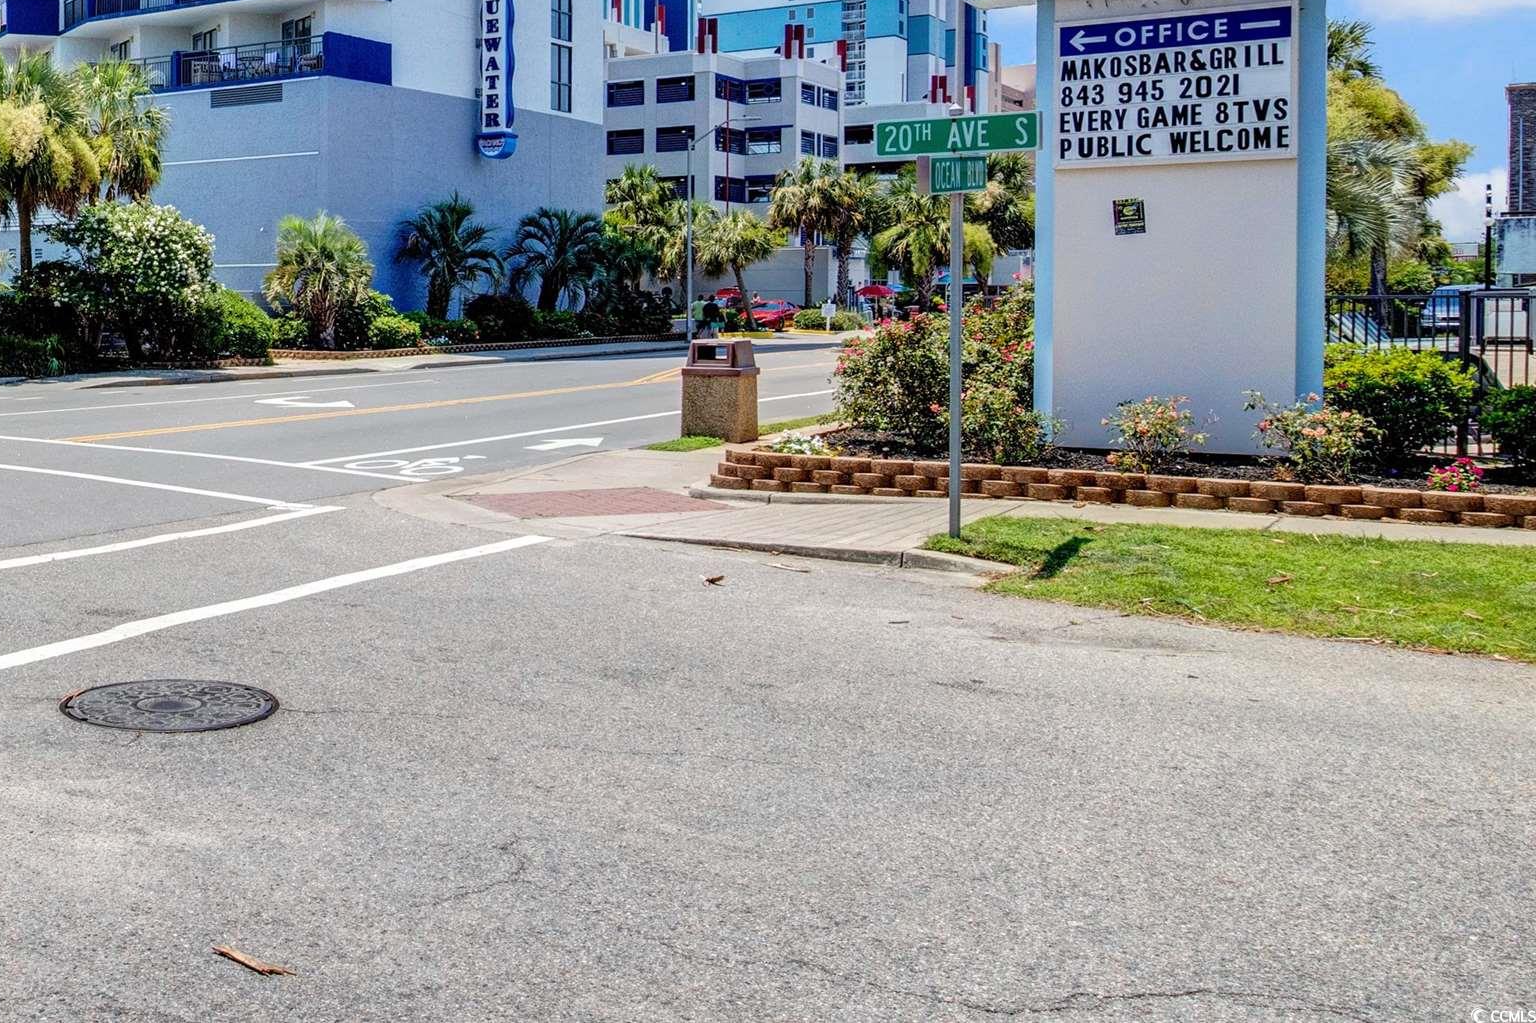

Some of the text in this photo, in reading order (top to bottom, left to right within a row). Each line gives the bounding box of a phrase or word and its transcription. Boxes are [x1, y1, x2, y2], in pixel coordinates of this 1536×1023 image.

[1114, 18, 1228, 47] OFFICE
[1061, 74, 1240, 107] 843 945 2021
[884, 117, 1028, 152] 20TH AVE S
[1060, 108, 1127, 134] EVERY
[1137, 103, 1202, 129] GAME
[1060, 125, 1290, 160] PUBLIC WELCOME
[935, 159, 984, 189] OCEAN BLVD
